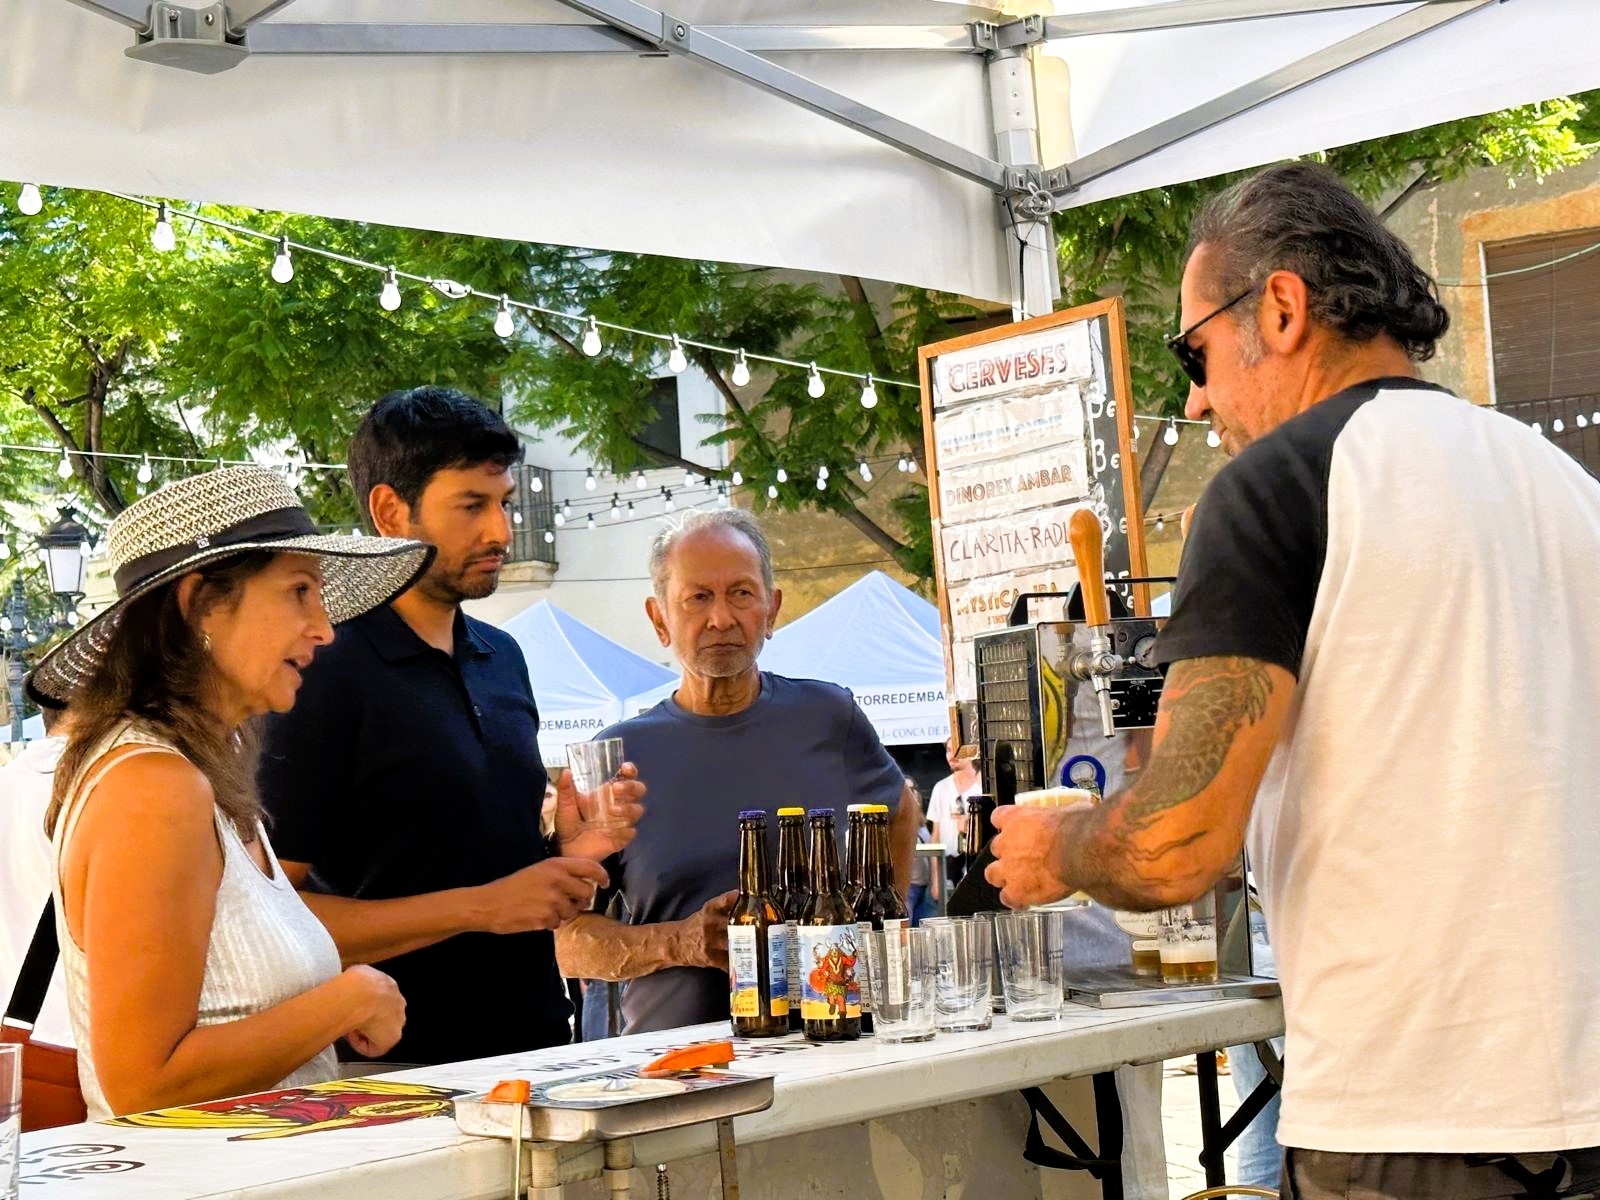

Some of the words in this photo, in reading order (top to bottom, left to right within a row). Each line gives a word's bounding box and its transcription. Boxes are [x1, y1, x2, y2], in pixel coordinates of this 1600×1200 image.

[947, 343, 1069, 393] CERVESES
[946, 477, 1014, 507] DINOREX
[1018, 464, 1073, 493] AMBAR
[856, 690, 945, 706] TORREDEMBA
[892, 726, 926, 738] CONCA
[927, 726, 941, 736] DE
